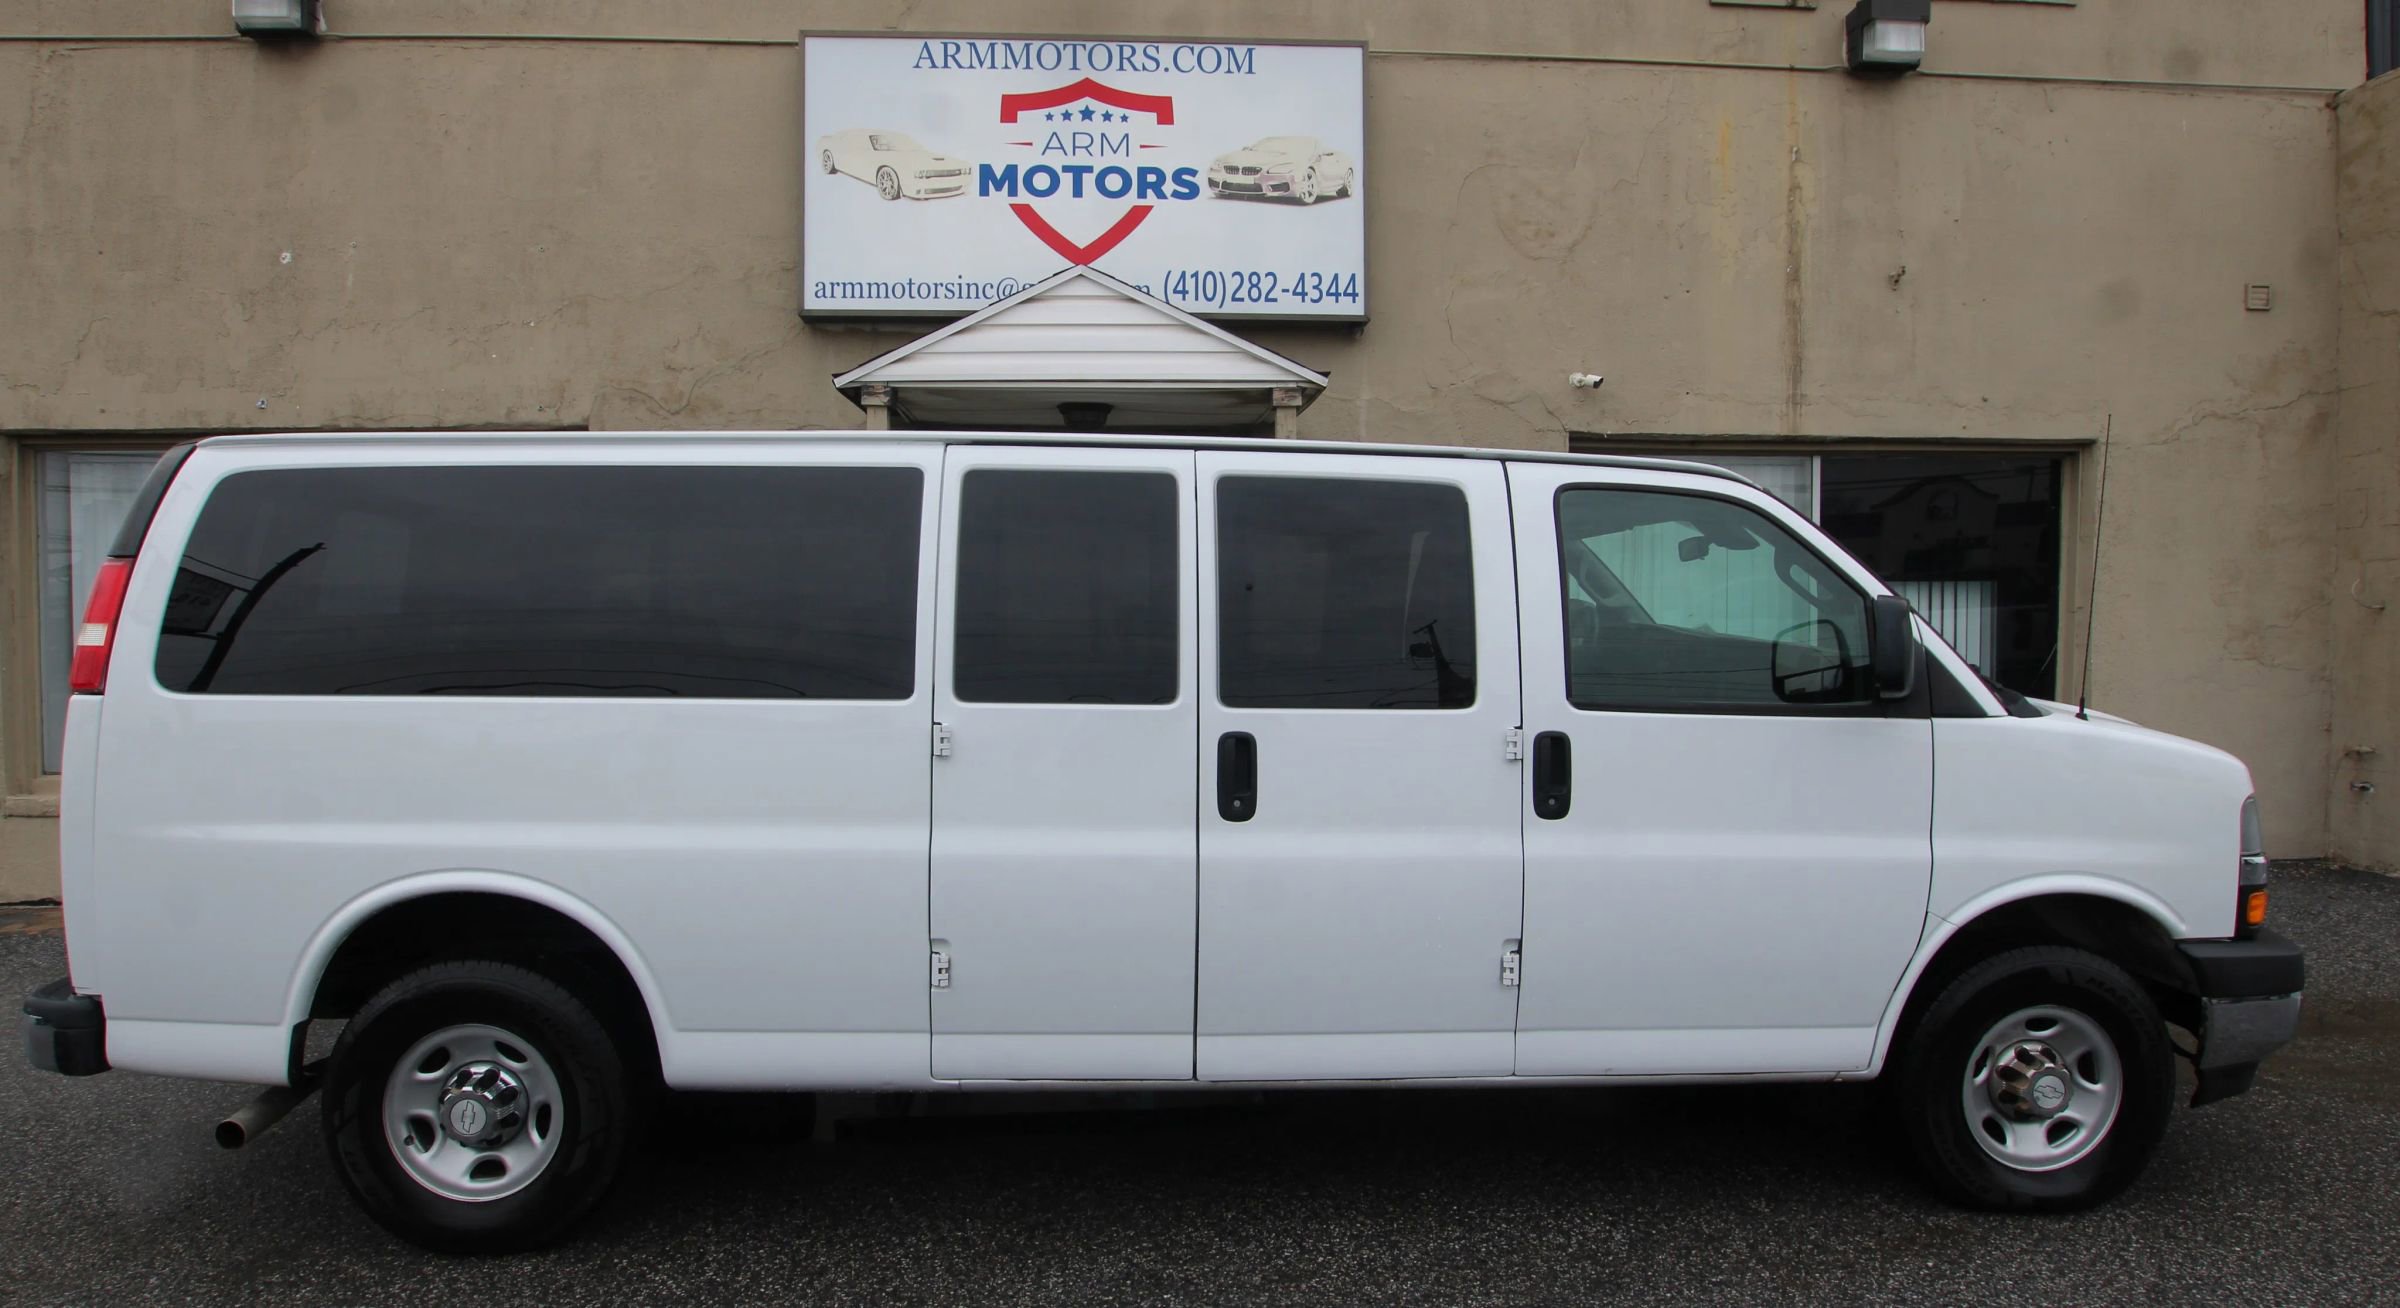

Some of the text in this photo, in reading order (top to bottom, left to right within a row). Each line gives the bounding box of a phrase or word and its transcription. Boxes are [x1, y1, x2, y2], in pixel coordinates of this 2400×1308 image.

[913, 41, 1256, 75] ARMMOTORS.COM
[1042, 131, 1131, 158] ARM
[979, 163, 1201, 201] MOTORS
[1163, 270, 1360, 307] (410)282-4344
